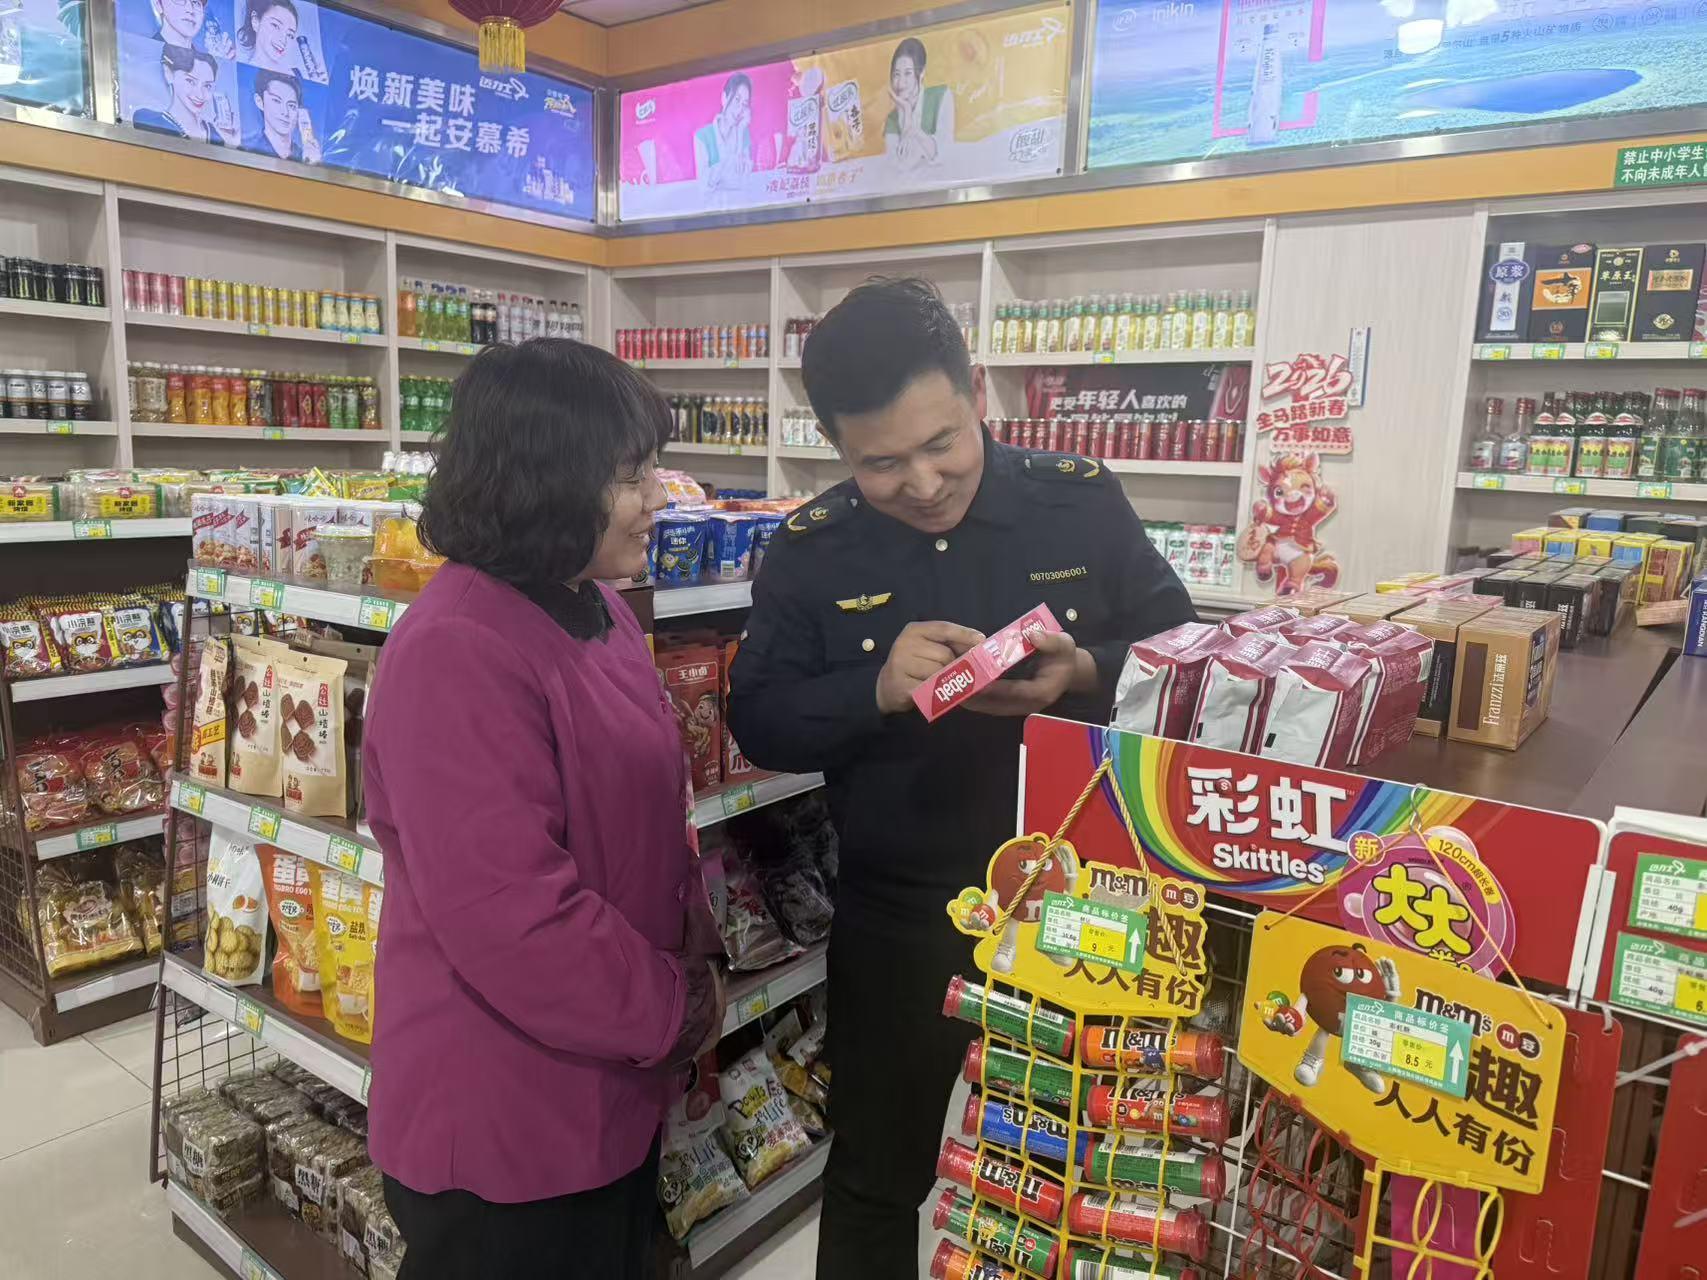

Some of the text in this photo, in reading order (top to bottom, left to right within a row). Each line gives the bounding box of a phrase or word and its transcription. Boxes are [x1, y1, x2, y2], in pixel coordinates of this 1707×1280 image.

[349, 65, 476, 117] 焕新美味
[381, 113, 530, 158] 一起安慕希
[1262, 353, 1353, 400] 2026
[1051, 389, 1187, 411] 更受年轻人喜欢的
[1273, 426, 1351, 443] 万事如意
[1030, 566, 1087, 580] 00703006001
[68, 617, 95, 628] 小浣熊
[934, 668, 975, 703] nabati
[1187, 767, 1348, 853] 彩虹
[1213, 843, 1325, 884] Skittles
[1354, 837, 1379, 860] 新
[1372, 863, 1472, 955] 大大
[1091, 943, 1097, 952] 9
[1064, 961, 1200, 1011] 人人有份
[1395, 1010, 1449, 1033] 商品标价签
[1405, 1054, 1419, 1067] 8.5
[1375, 1081, 1535, 1175] 人人有份
